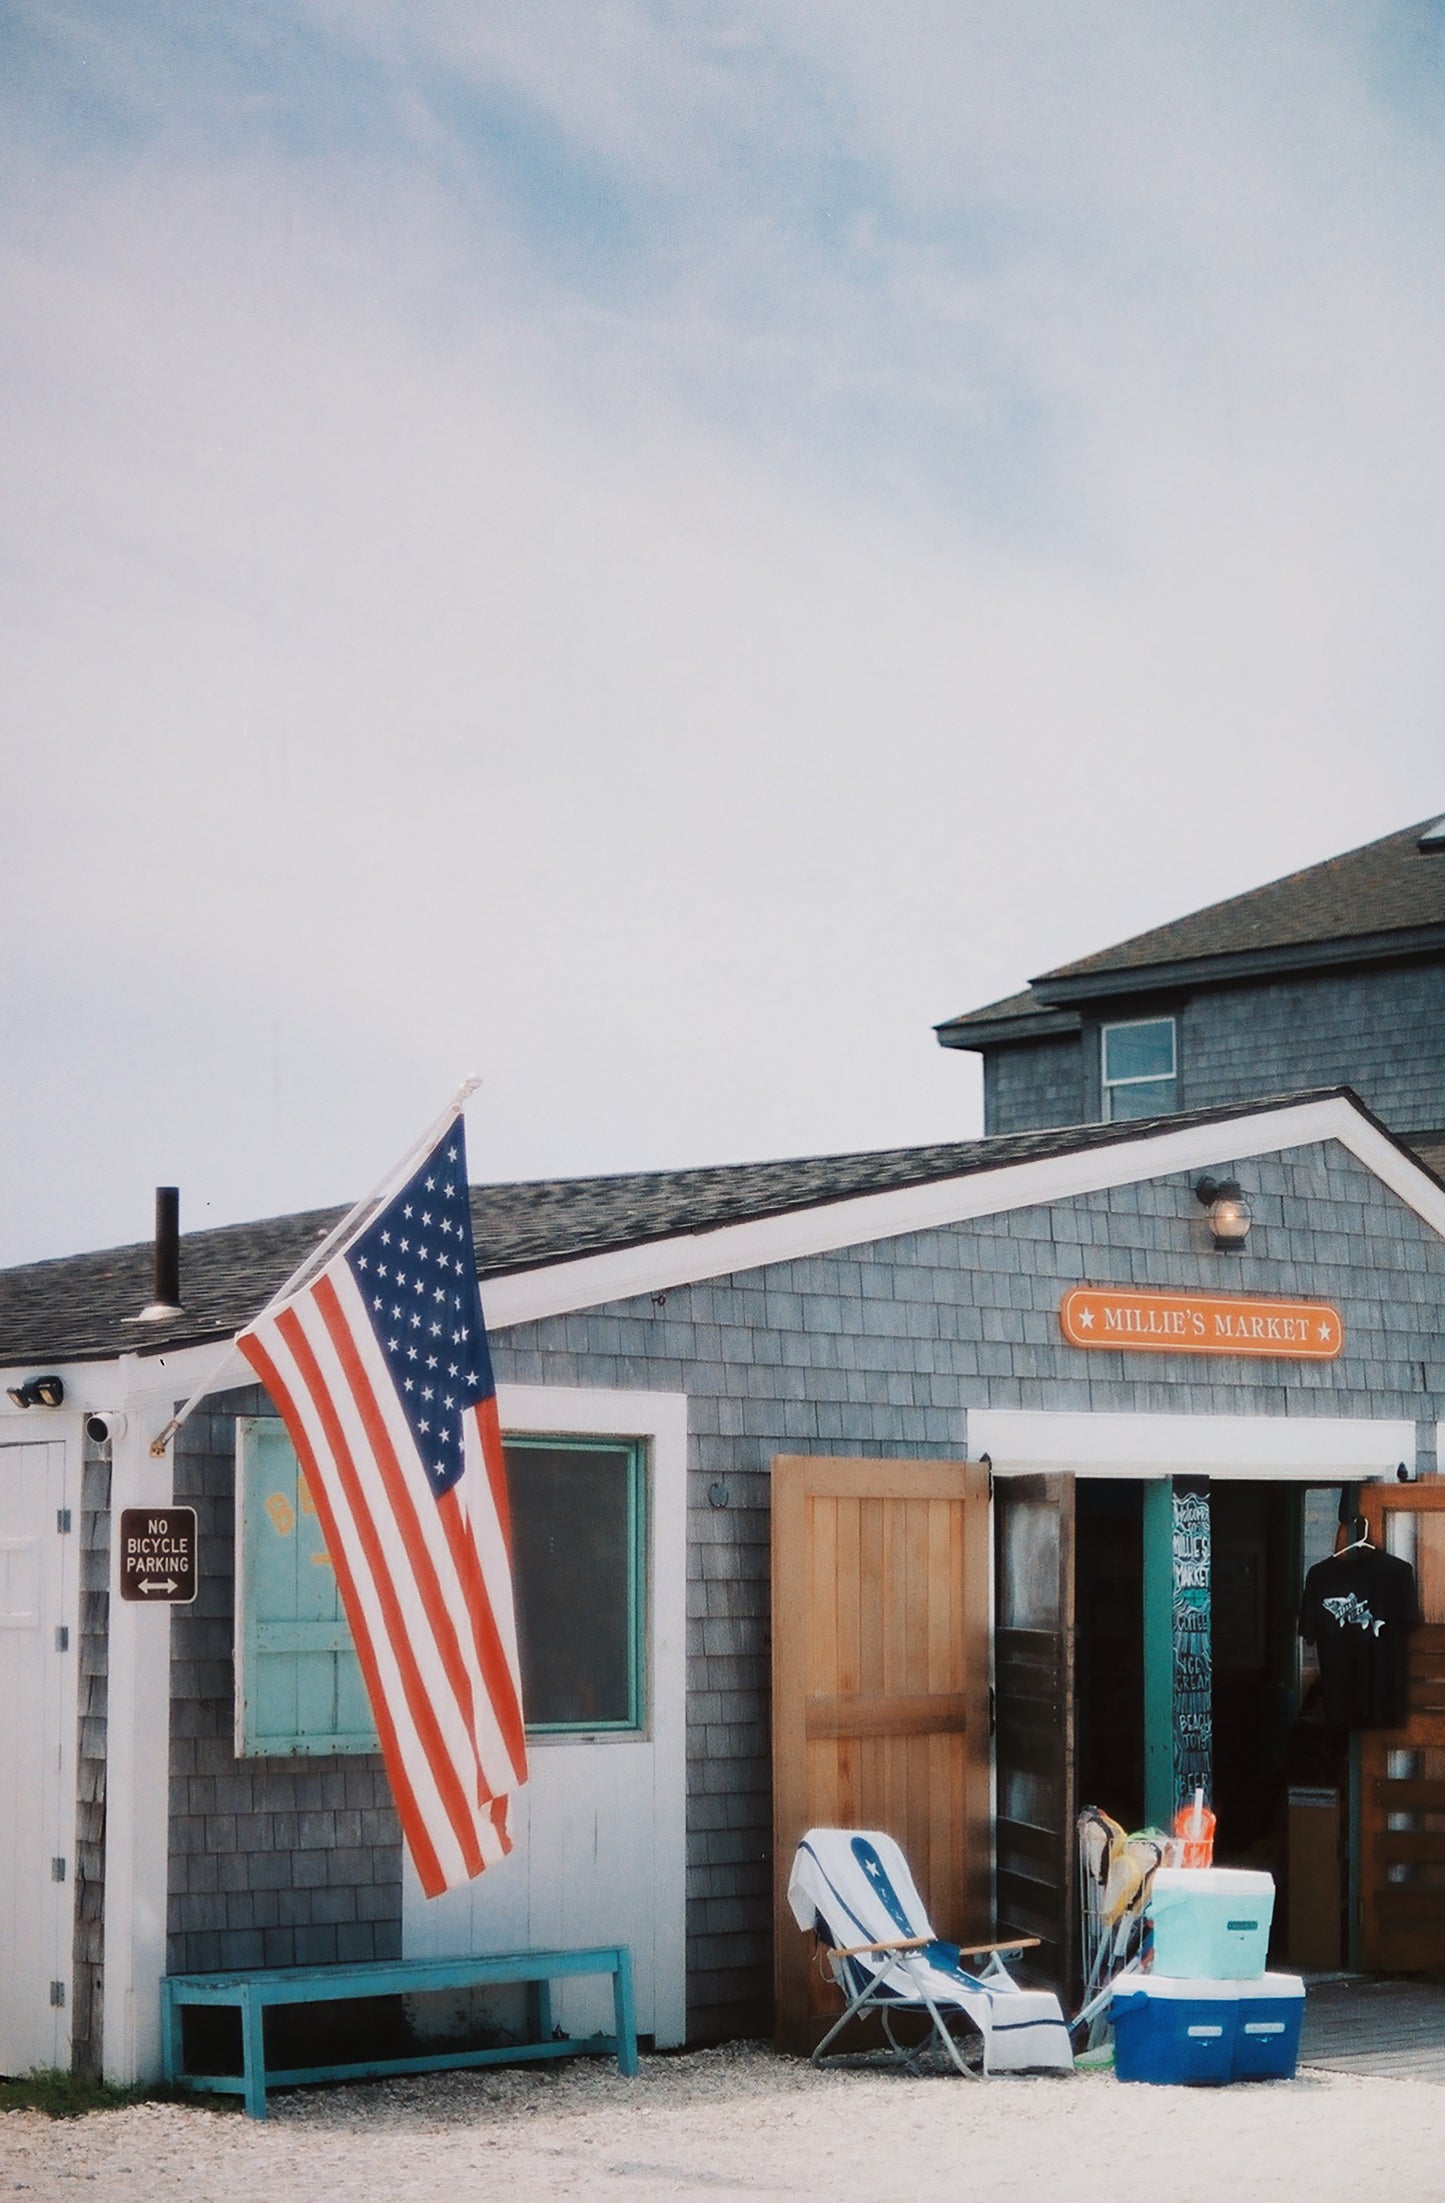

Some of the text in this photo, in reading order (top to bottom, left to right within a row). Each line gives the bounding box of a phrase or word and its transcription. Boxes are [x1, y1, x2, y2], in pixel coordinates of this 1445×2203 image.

[1104, 1307, 1310, 1341] MILLIE'S MARKET
[148, 1519, 168, 1534] NO
[127, 1538, 188, 1553] BICYCLE
[126, 1557, 189, 1572] PARKING
[1174, 1565, 1210, 1587] MARKET
[1176, 1614, 1208, 1632] COFFEE
[1175, 1674, 1212, 1692] CREAM
[1179, 1714, 1212, 1733] BEACH
[1179, 1773, 1208, 1794] BEER
